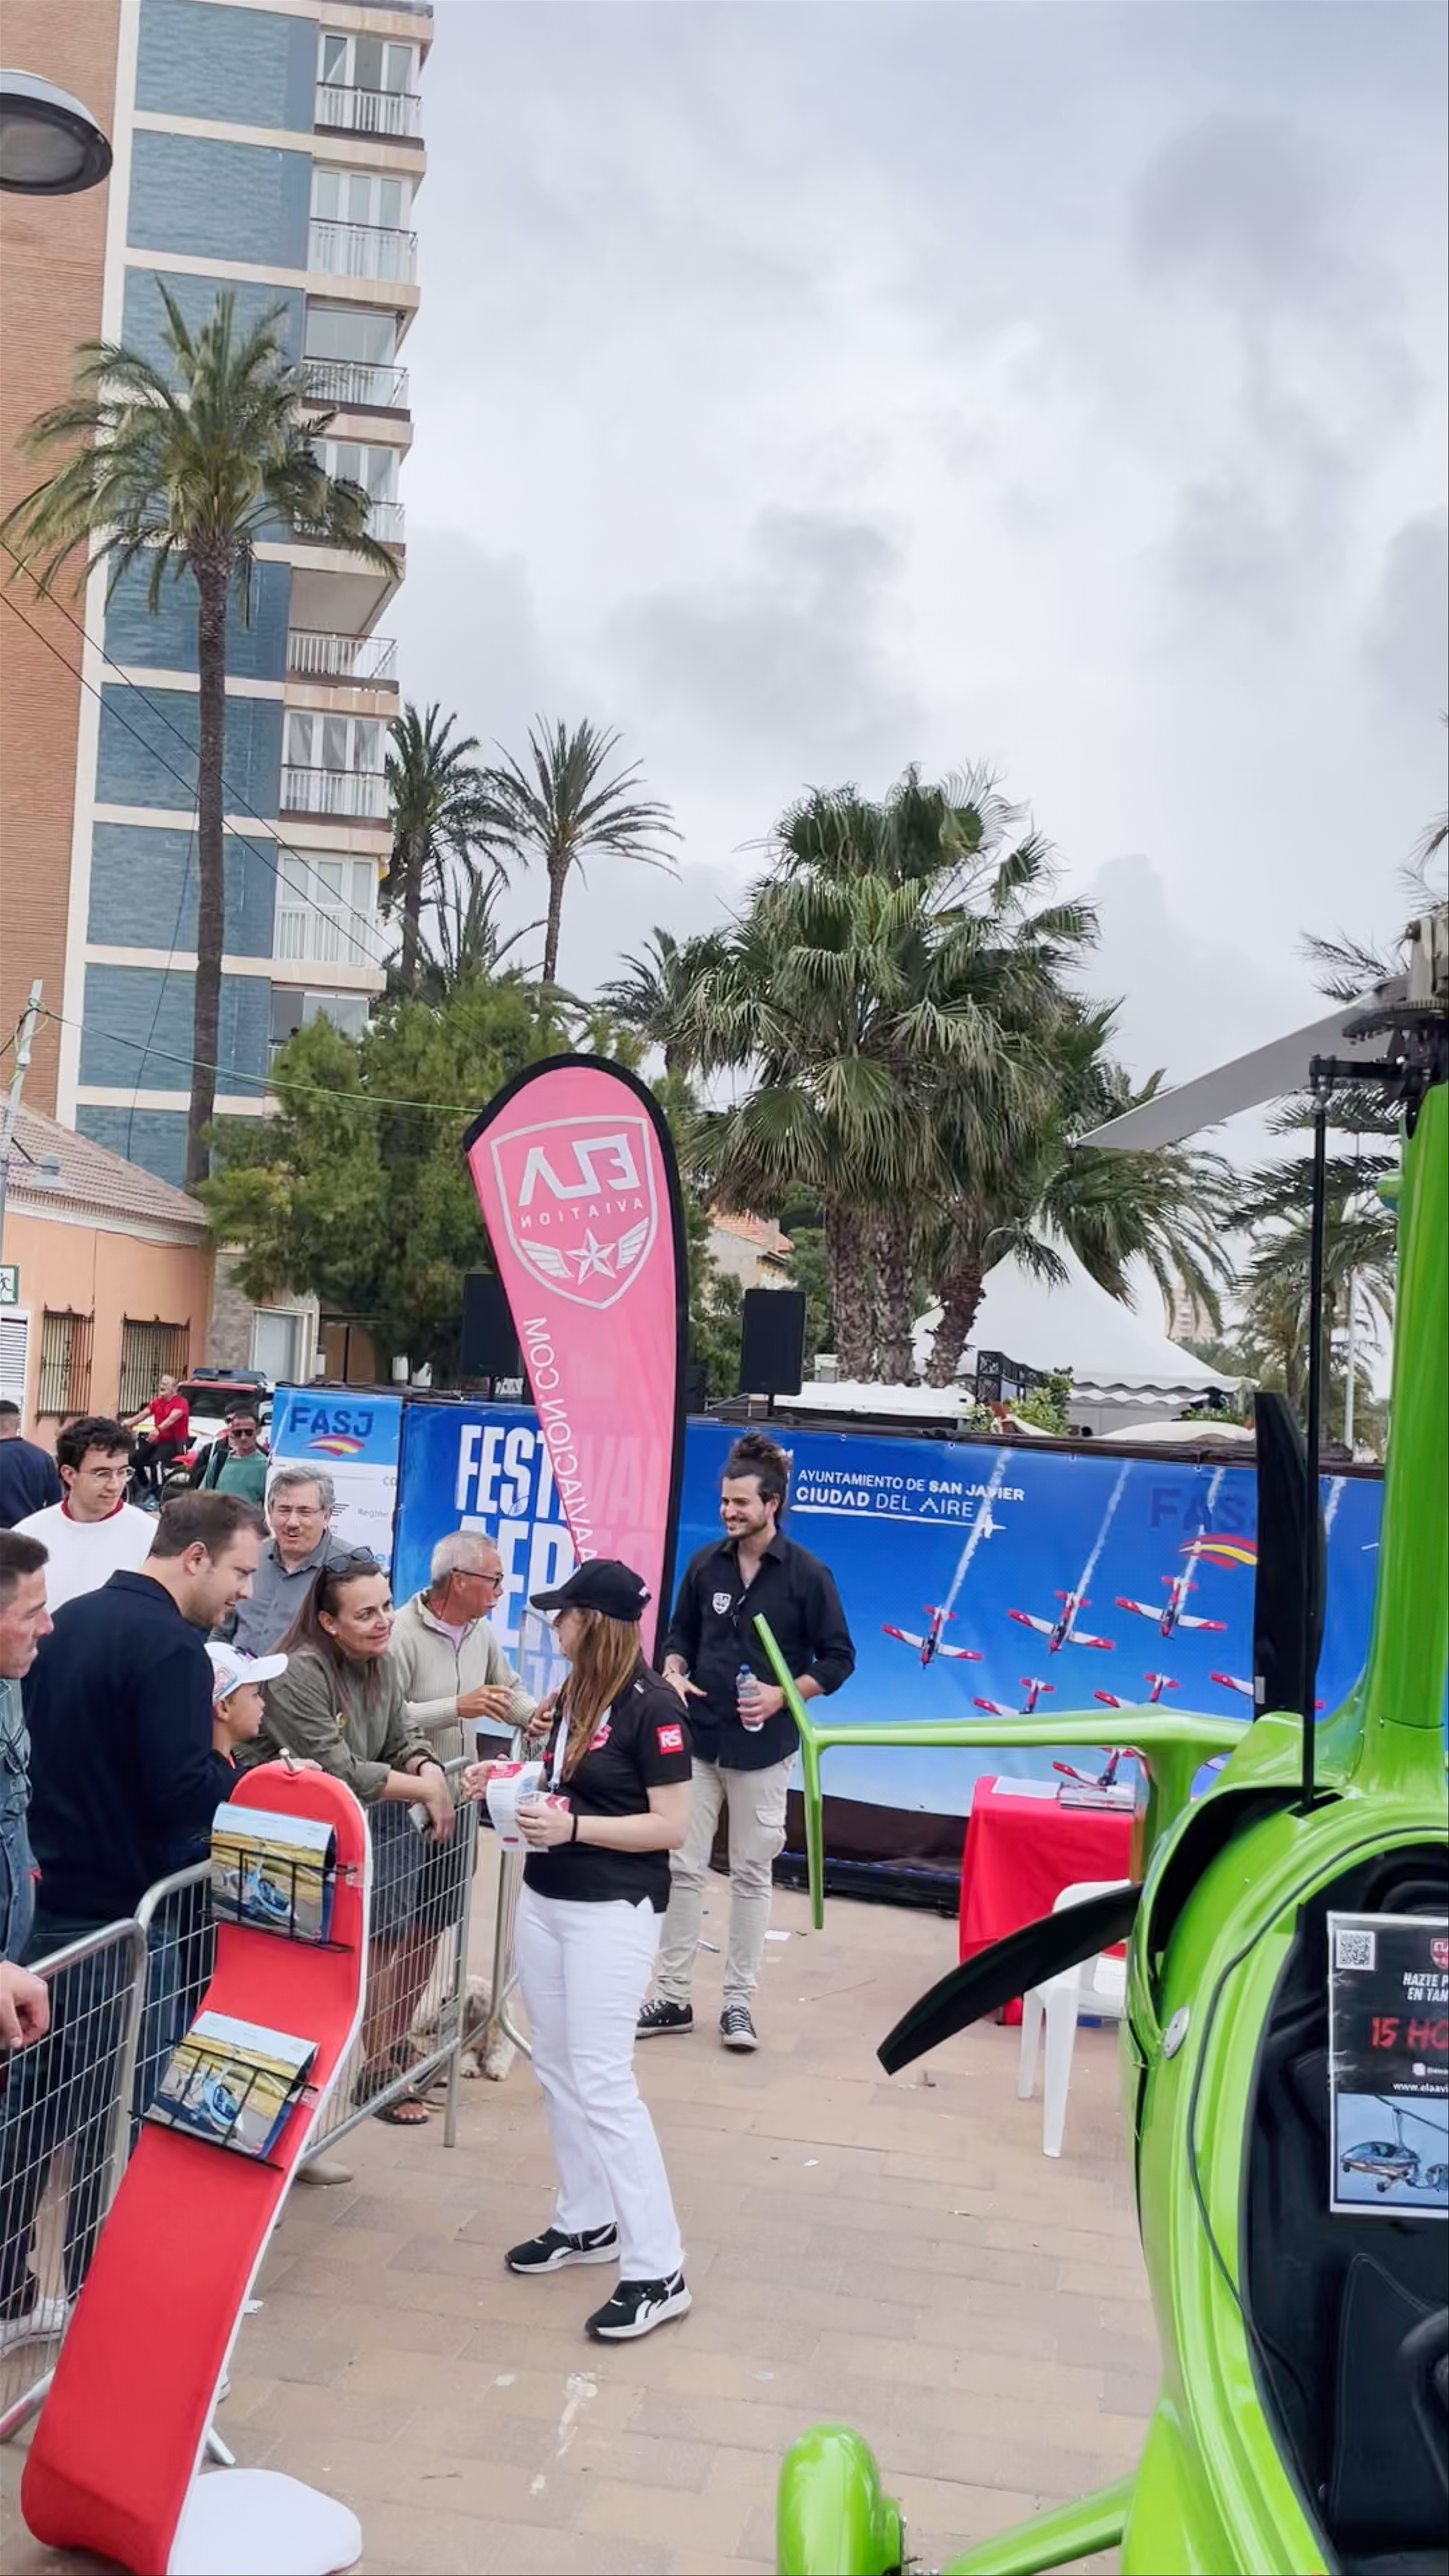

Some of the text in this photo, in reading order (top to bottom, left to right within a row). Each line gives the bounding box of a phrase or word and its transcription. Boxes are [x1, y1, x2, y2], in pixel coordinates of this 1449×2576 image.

[289, 1406, 374, 1437] FASJ
[798, 1470, 1025, 1501] AYUNTAMIENTO DE SAN JAVIER
[796, 1486, 974, 1517] CIUDAD DEL AIRE
[1151, 1487, 1256, 1533] FAS
[1403, 1972, 1439, 1987] HAZTE
[1407, 1987, 1423, 2000] EN
[1372, 2017, 1400, 2047] 15
